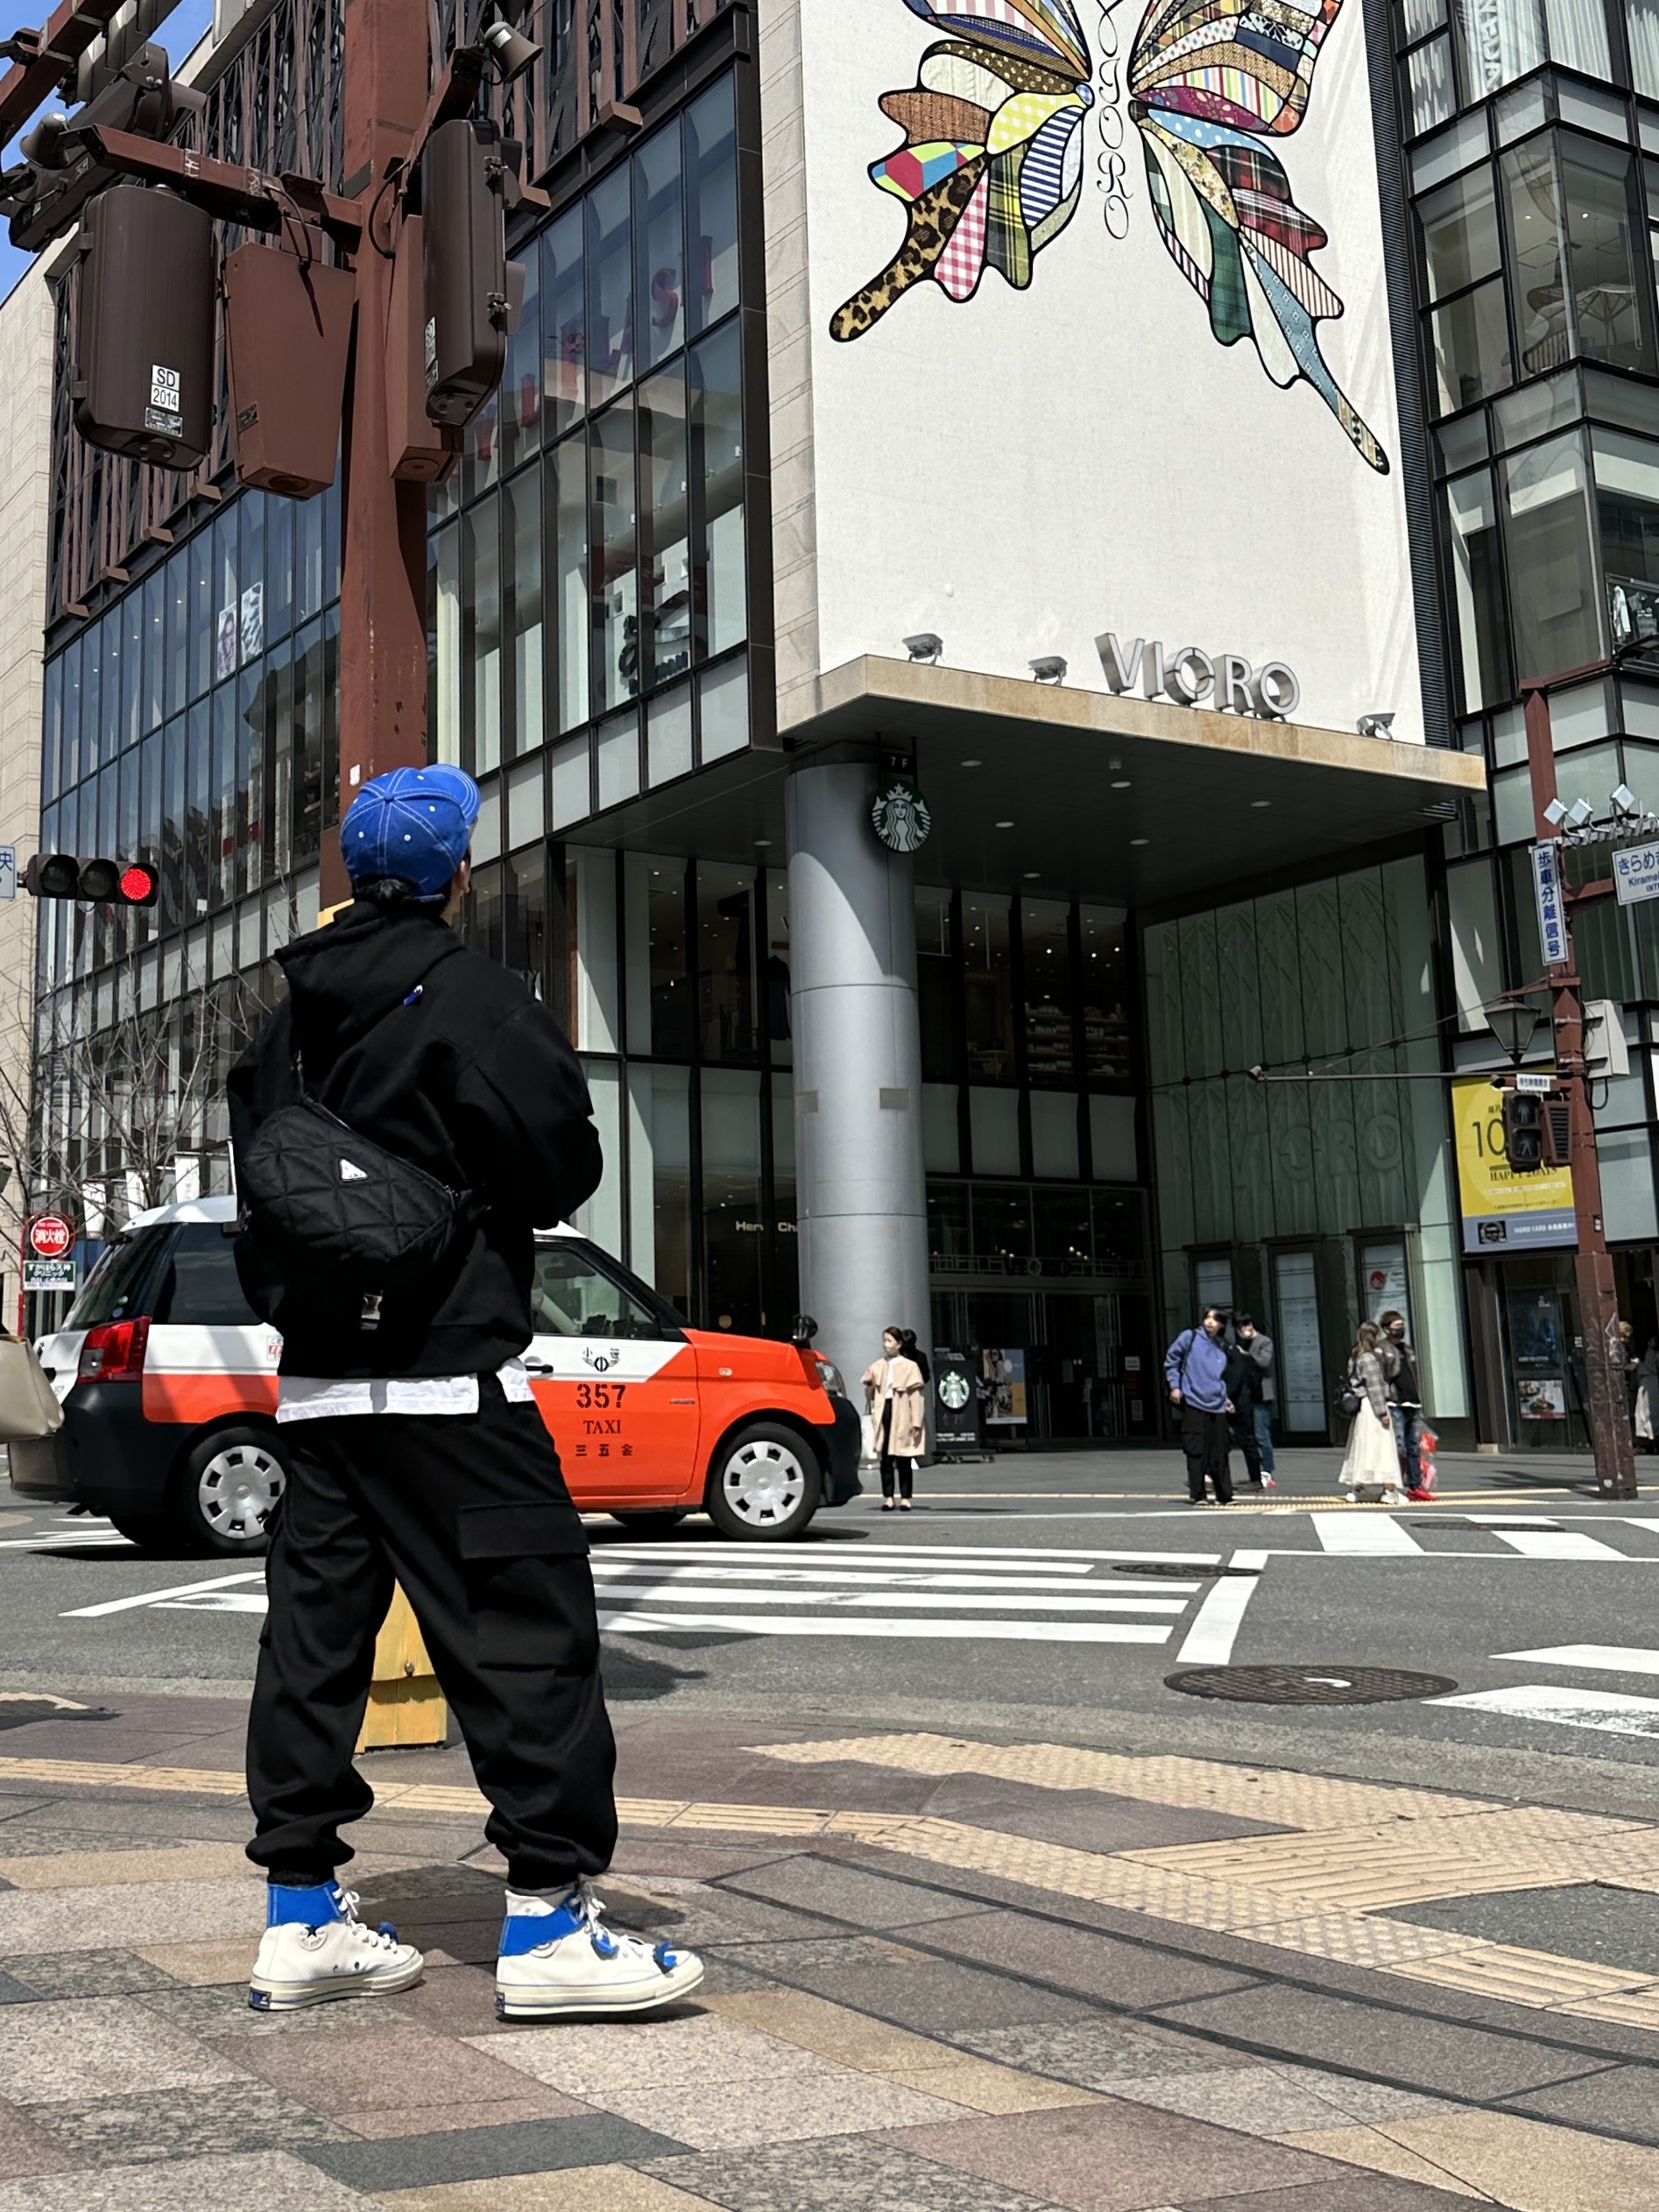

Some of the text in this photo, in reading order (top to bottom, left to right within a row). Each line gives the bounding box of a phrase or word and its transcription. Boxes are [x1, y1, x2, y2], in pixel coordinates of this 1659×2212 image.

[157, 368, 175, 387] SD
[152, 387, 178, 409] 2014
[1095, 633, 1300, 718] VIORO
[1619, 848, 1659, 875] きらめ
[1628, 872, 1659, 887] Kirame
[1537, 851, 1561, 958] 歩車分離信号
[35, 1228, 66, 1244] 消火栓
[576, 1383, 626, 1409] 357
[582, 1419, 622, 1435] TAXI
